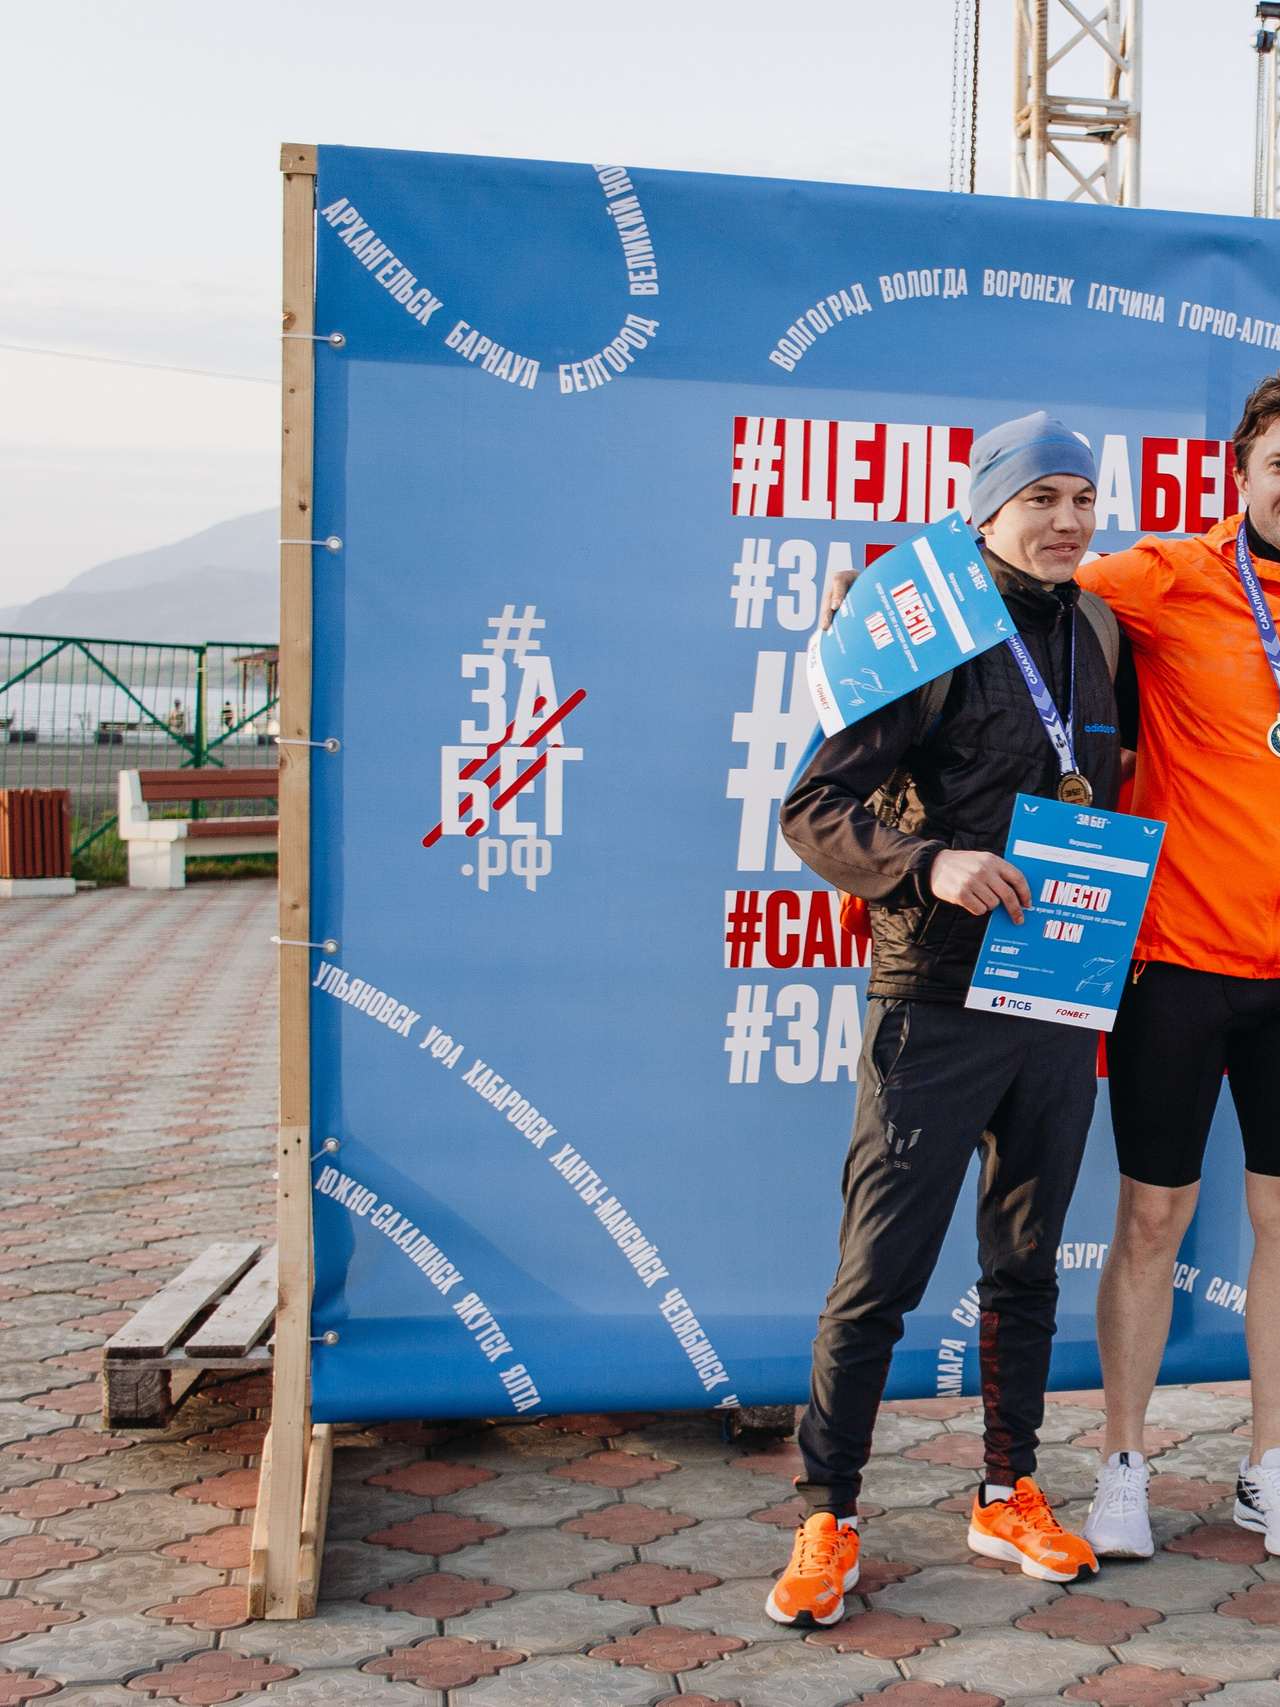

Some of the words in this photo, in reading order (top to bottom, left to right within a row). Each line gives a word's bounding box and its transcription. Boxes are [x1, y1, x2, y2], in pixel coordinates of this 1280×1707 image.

[321, 197, 444, 326] АРХАНГЕЛЬСК
[606, 195, 660, 296] ВЕЛИКИЙ
[444, 320, 540, 389] БАРНАУЛ
[558, 313, 660, 394] БЕЛГОРОД
[768, 283, 873, 372] ВОЛГОГРАД
[879, 268, 968, 304] ВОЛОГДА
[983, 269, 1075, 305] ВОРОНЕЖ
[1087, 282, 1165, 323] ГАТЧИНА
[732, 416, 974, 525] #ЦЕЛЬ
[893, 587, 937, 647] МЕСТО
[1241, 563, 1270, 630] САХАЛИНСКАЯ
[460, 654, 565, 745] ЗА
[816, 683, 830, 711] FONBET
[441, 745, 584, 836] БЕГ
[1043, 919, 1061, 940] 10
[1061, 922, 1085, 943] КМ
[1055, 880, 1112, 913] МЕСТО
[1007, 1000, 1032, 1011] ПСБ
[1055, 1008, 1090, 1020] FONBET
[312, 960, 421, 1037] УЛЬЯНОВСК
[419, 1025, 465, 1069] УФА
[462, 1059, 558, 1149] ХАБАРОВСК
[549, 1143, 670, 1289] ХАНТЫ-МАНСИЙСК
[658, 1288, 730, 1392] ЧЕЛЯБИНСК
[314, 1165, 464, 1296] ЮЖНО-САХАЛИНСК
[452, 1292, 514, 1363] ЯКУТСК
[499, 1363, 542, 1413] ЯЛТА
[936, 1338, 967, 1398] АМАРА
